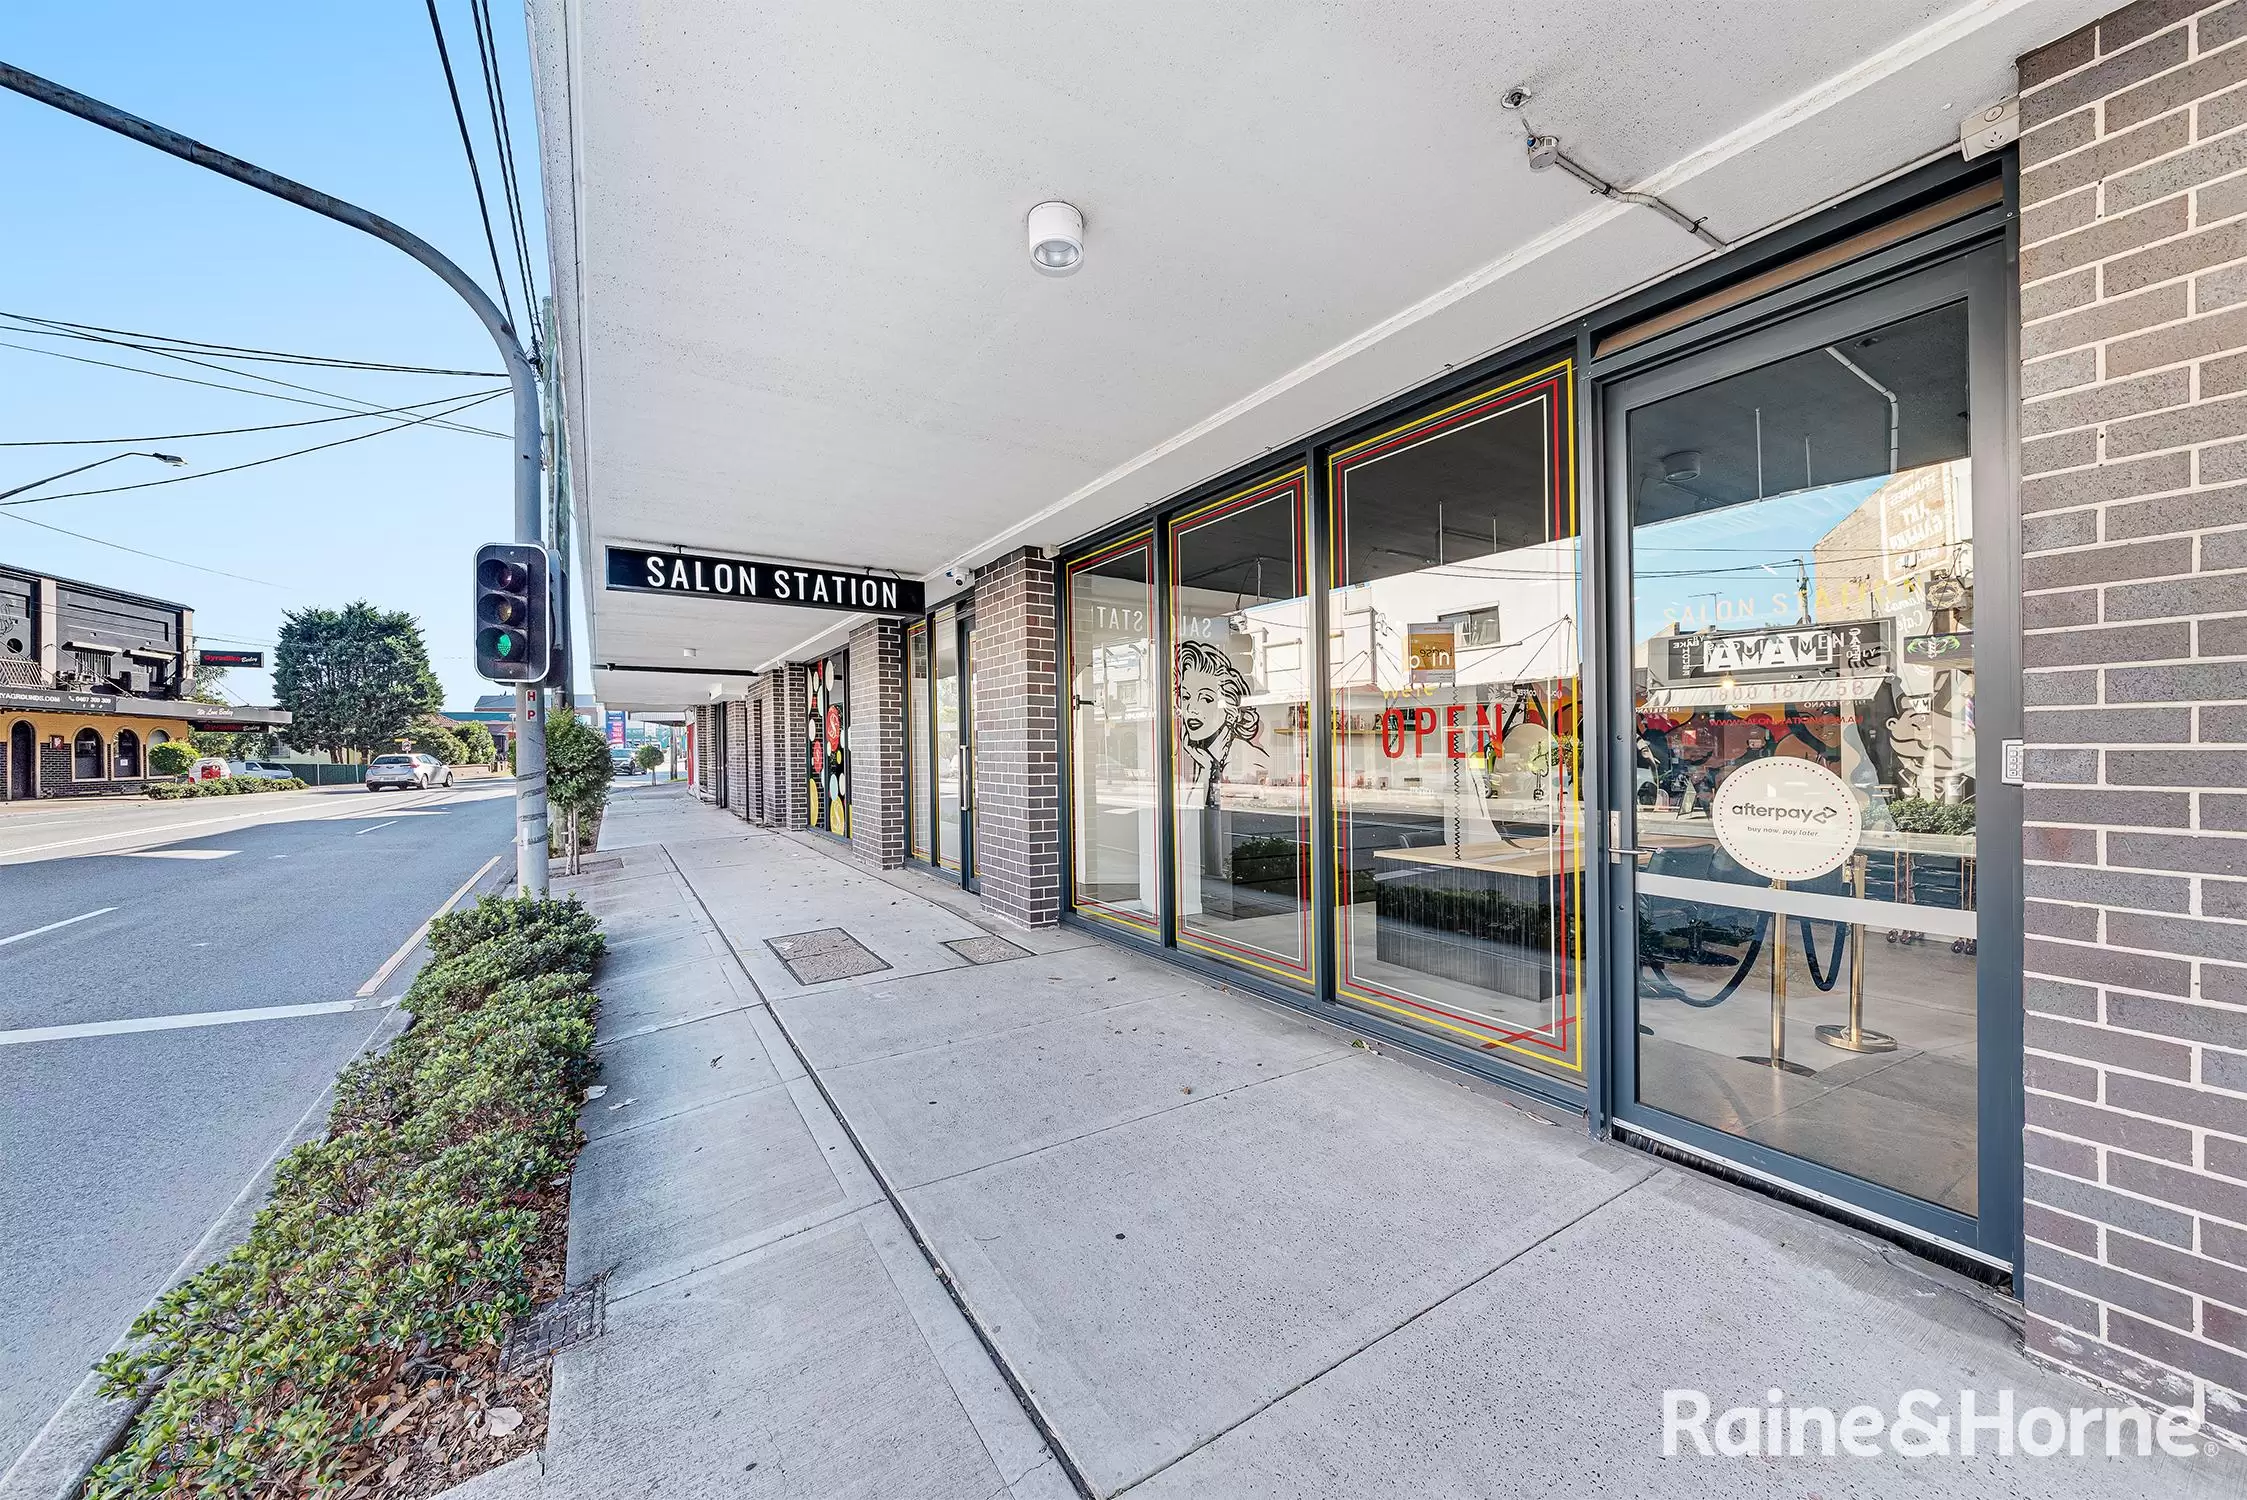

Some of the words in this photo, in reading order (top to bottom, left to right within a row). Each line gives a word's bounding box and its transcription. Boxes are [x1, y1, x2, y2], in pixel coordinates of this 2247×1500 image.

[646, 557, 757, 596] SALON
[775, 570, 898, 609] STATION
[1663, 597, 1755, 626] SALON
[1382, 703, 1503, 759] OPEN
[1732, 803, 1813, 823] afterpay
[1747, 826, 1762, 835] buy
[1782, 828, 1798, 837] pay
